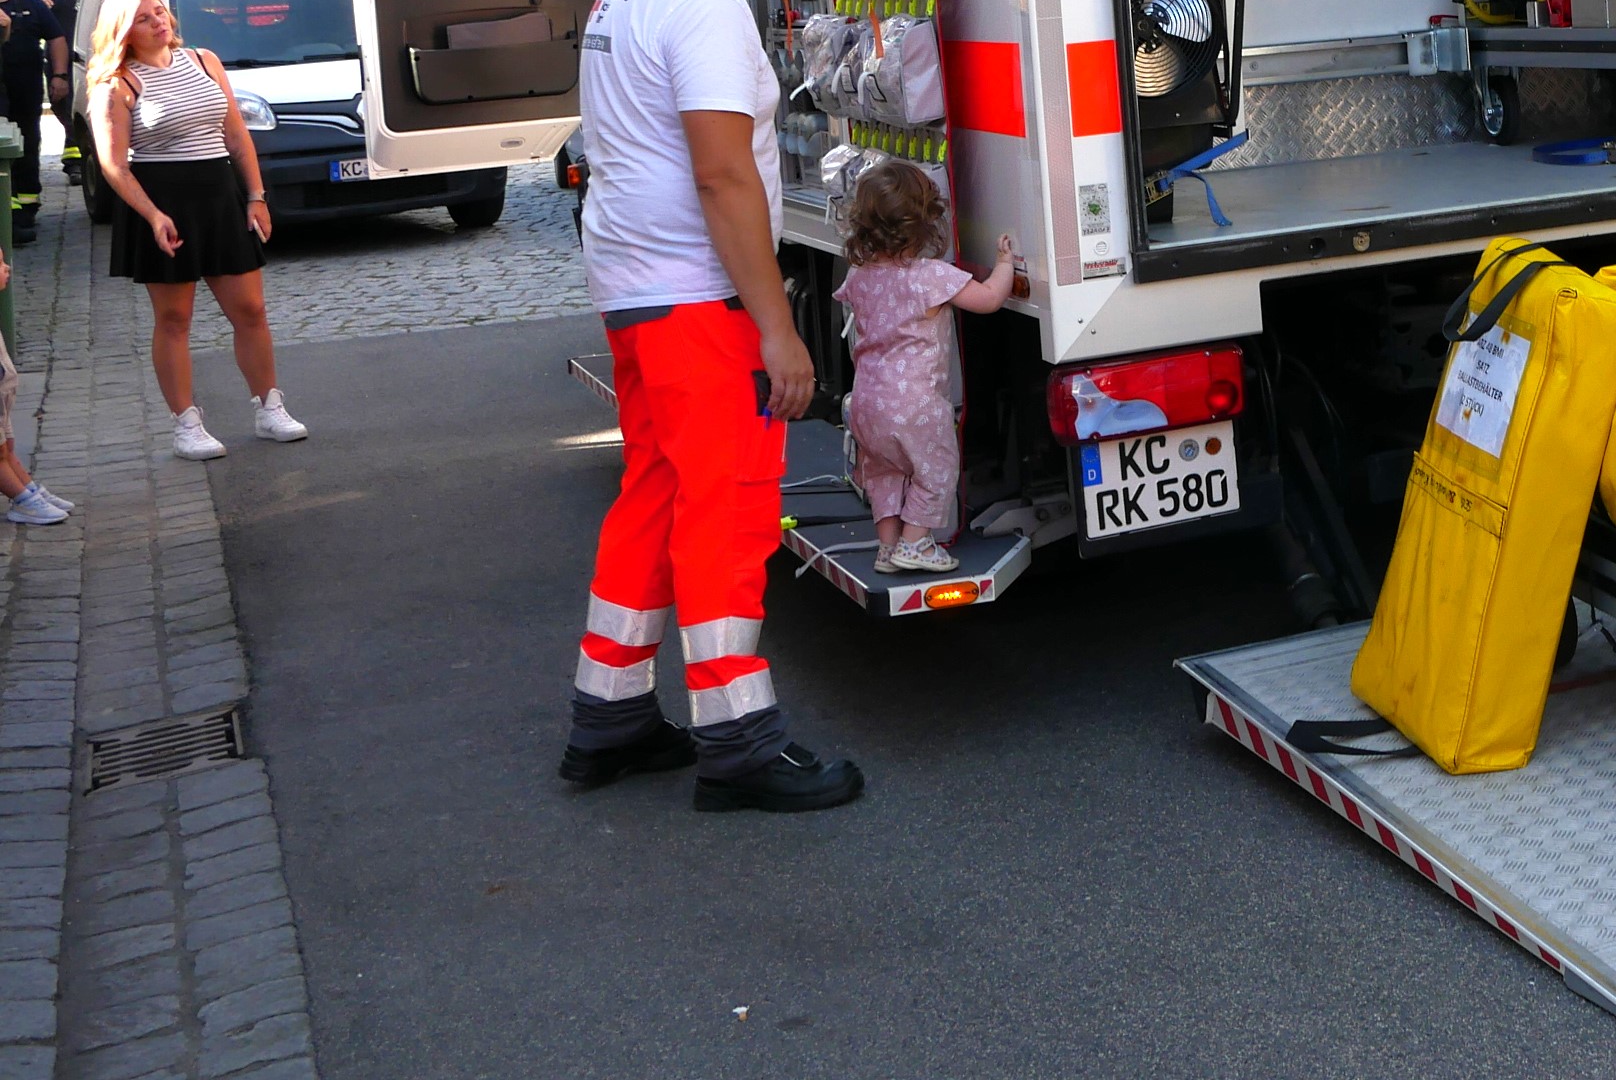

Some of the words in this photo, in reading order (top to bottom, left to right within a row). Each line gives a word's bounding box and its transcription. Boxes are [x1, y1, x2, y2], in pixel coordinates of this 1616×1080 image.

[341, 161, 362, 177] KC
[1476, 360, 1490, 374] SATZ
[1457, 370, 1503, 402] BALLASTBEHÄLTER
[1464, 398, 1484, 416] STÜCK)
[1119, 435, 1170, 481] KC
[1088, 469, 1097, 481] D
[1096, 483, 1149, 531] RK
[1156, 469, 1229, 517] 580
